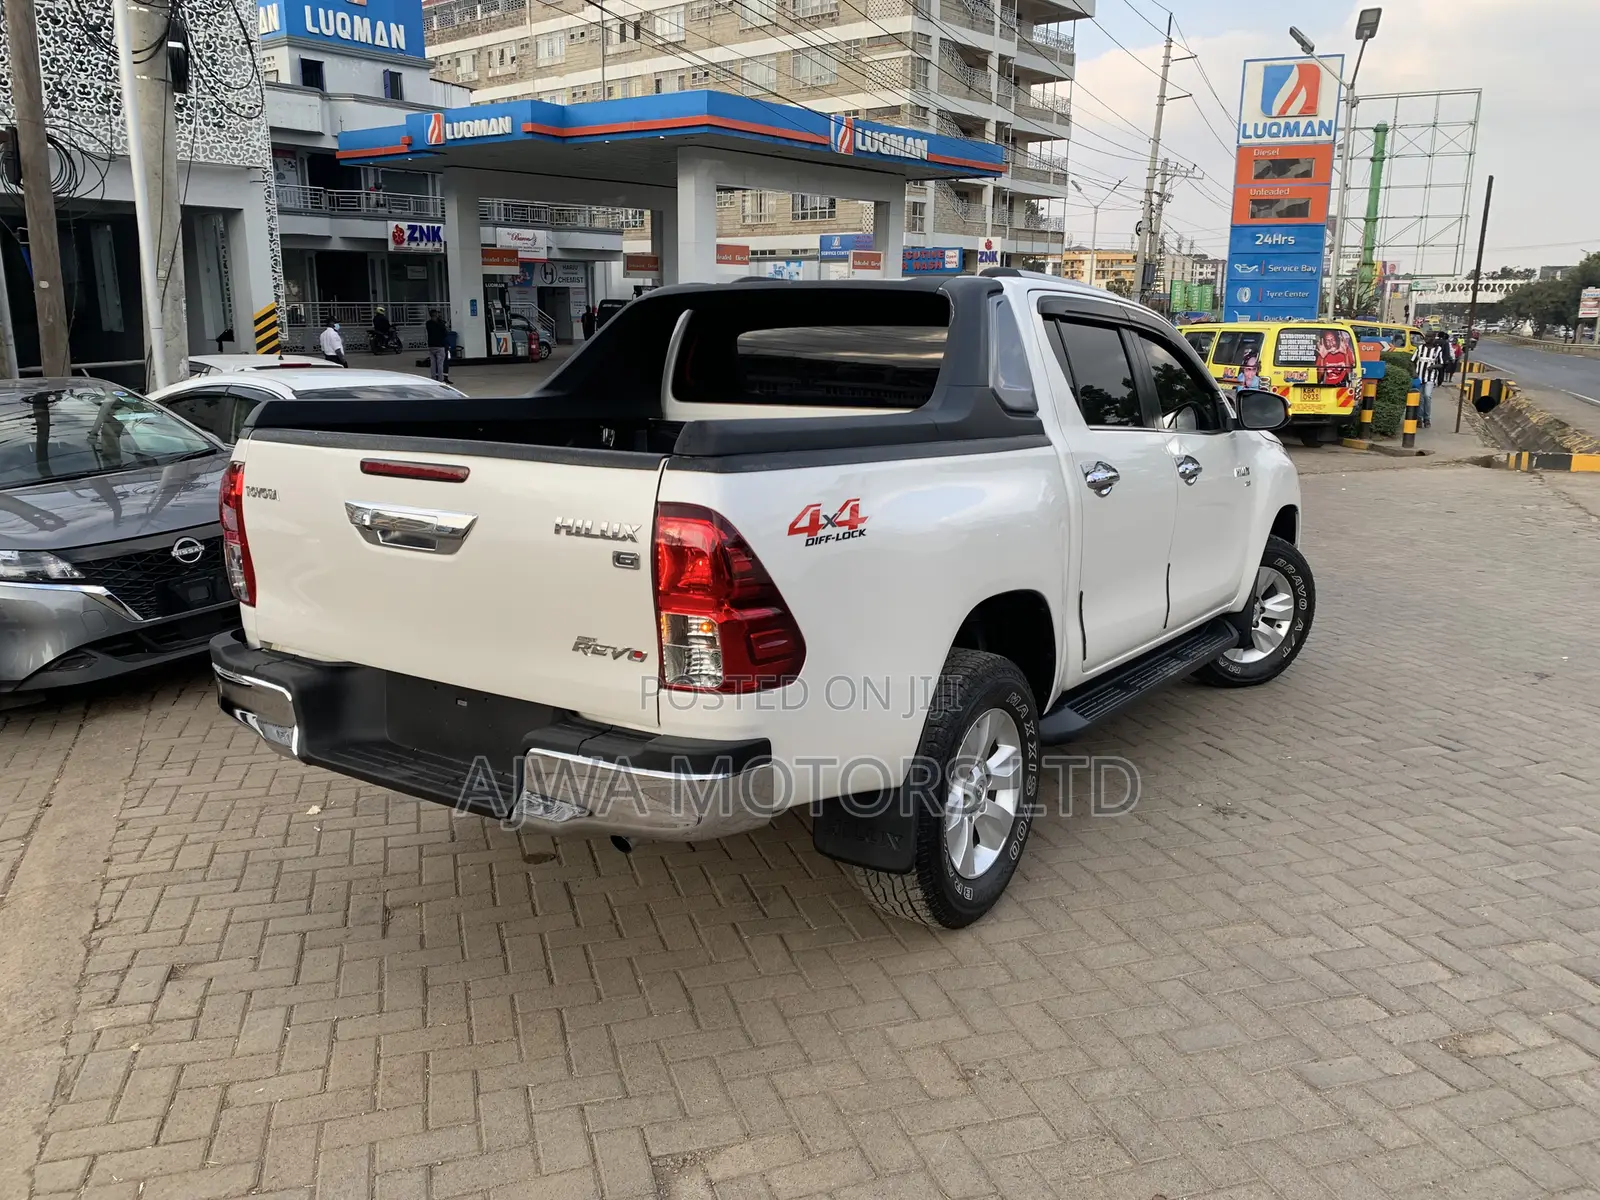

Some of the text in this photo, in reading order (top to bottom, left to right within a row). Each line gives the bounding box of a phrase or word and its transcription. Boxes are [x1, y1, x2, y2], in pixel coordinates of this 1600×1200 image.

[304, 5, 406, 50] LUQMAN
[445, 116, 512, 140] LUQMAN
[1241, 120, 1334, 139] LUQMAN
[855, 128, 928, 160] LUQMAN
[1253, 148, 1280, 156] Diesel
[1249, 188, 1290, 196] Unleaded
[407, 224, 442, 242] ZNK
[1255, 234, 1295, 245] 24Hrs
[902, 250, 944, 259] ECUTIVE
[979, 251, 998, 263] ZNK
[1301, 264, 1317, 273] Bay
[558, 276, 583, 284] CHEMIST
[245, 486, 280, 501] TOYOTA
[787, 498, 869, 537] 4x4
[554, 516, 642, 543] HILUX
[805, 528, 867, 547] DIFF-LOCK
[171, 545, 205, 557] NISSAN
[612, 551, 641, 570] G
[1273, 558, 1308, 611] BRAVO
[572, 641, 648, 662] REVO
[1006, 692, 1037, 797] MAXXIS
